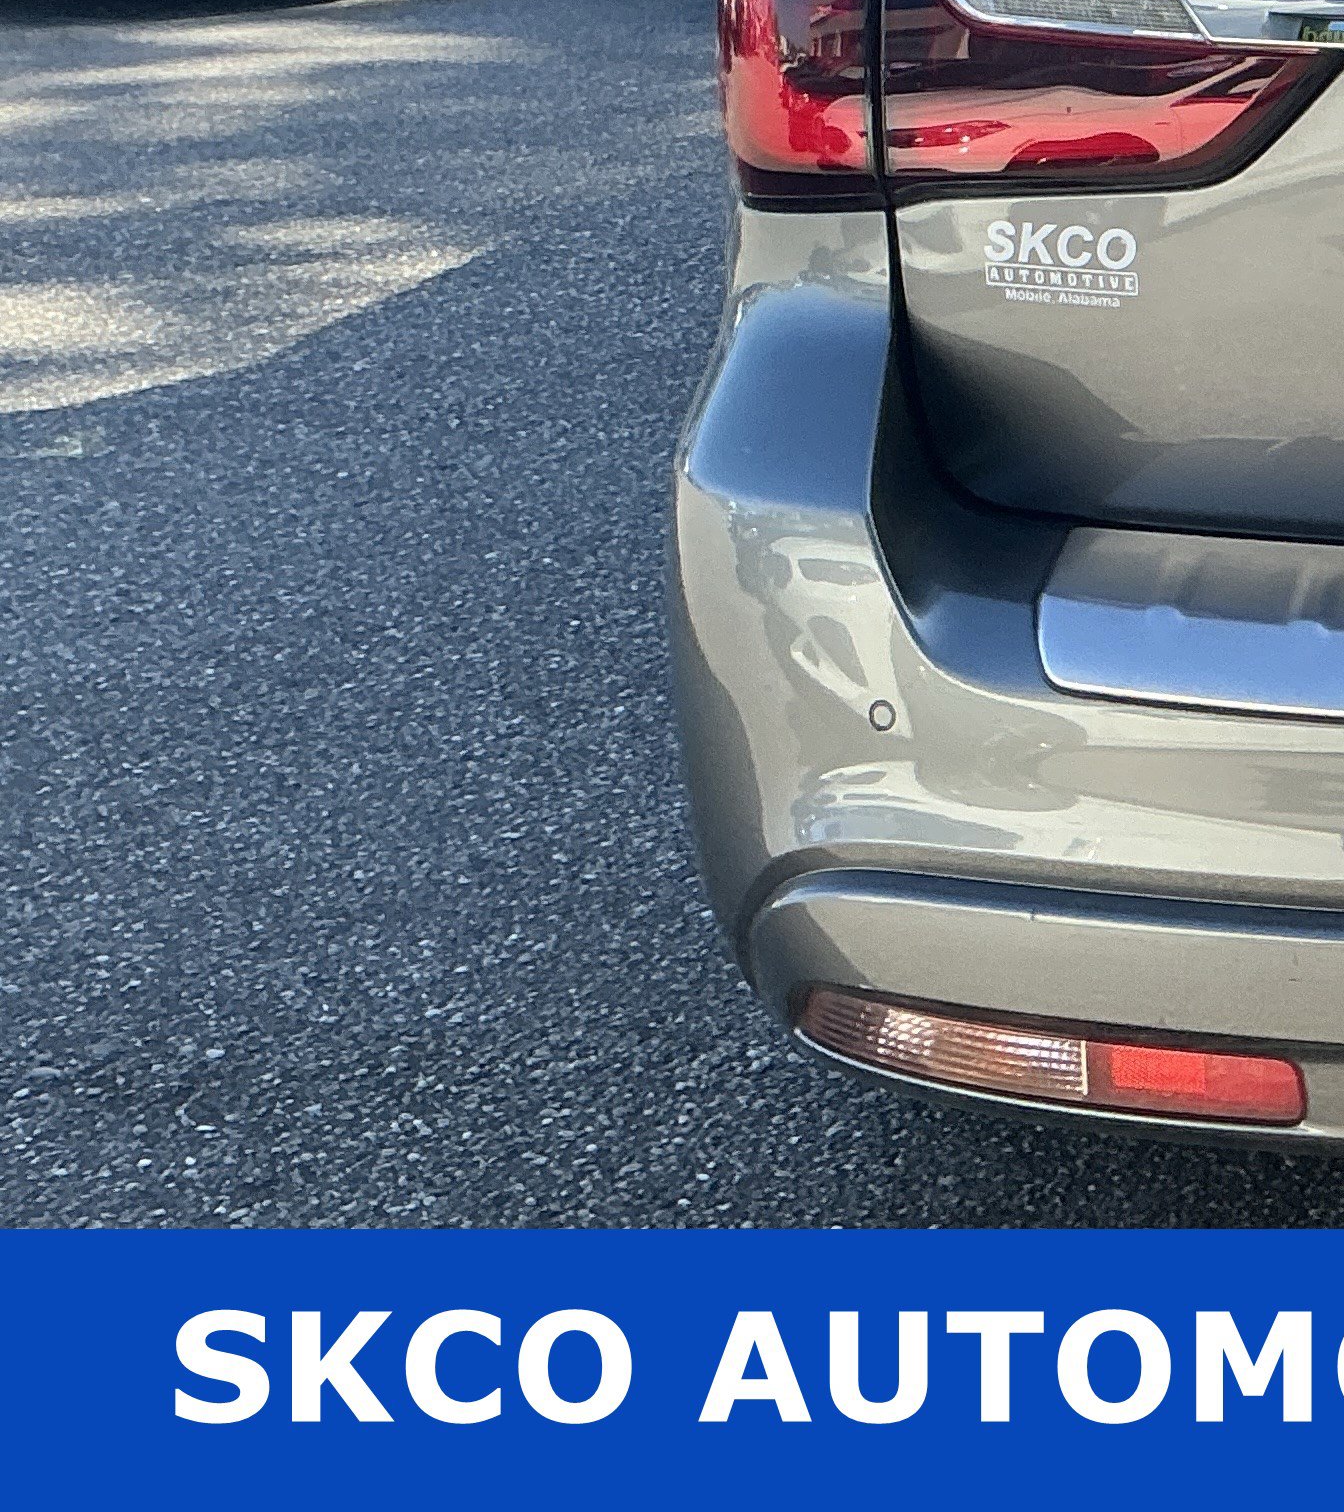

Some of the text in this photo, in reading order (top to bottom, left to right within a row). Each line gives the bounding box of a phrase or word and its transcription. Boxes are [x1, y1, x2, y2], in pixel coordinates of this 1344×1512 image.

[983, 220, 1137, 270] SKCO
[988, 266, 1136, 291] AUTOMOTIVE
[1058, 292, 1121, 308] Alabama
